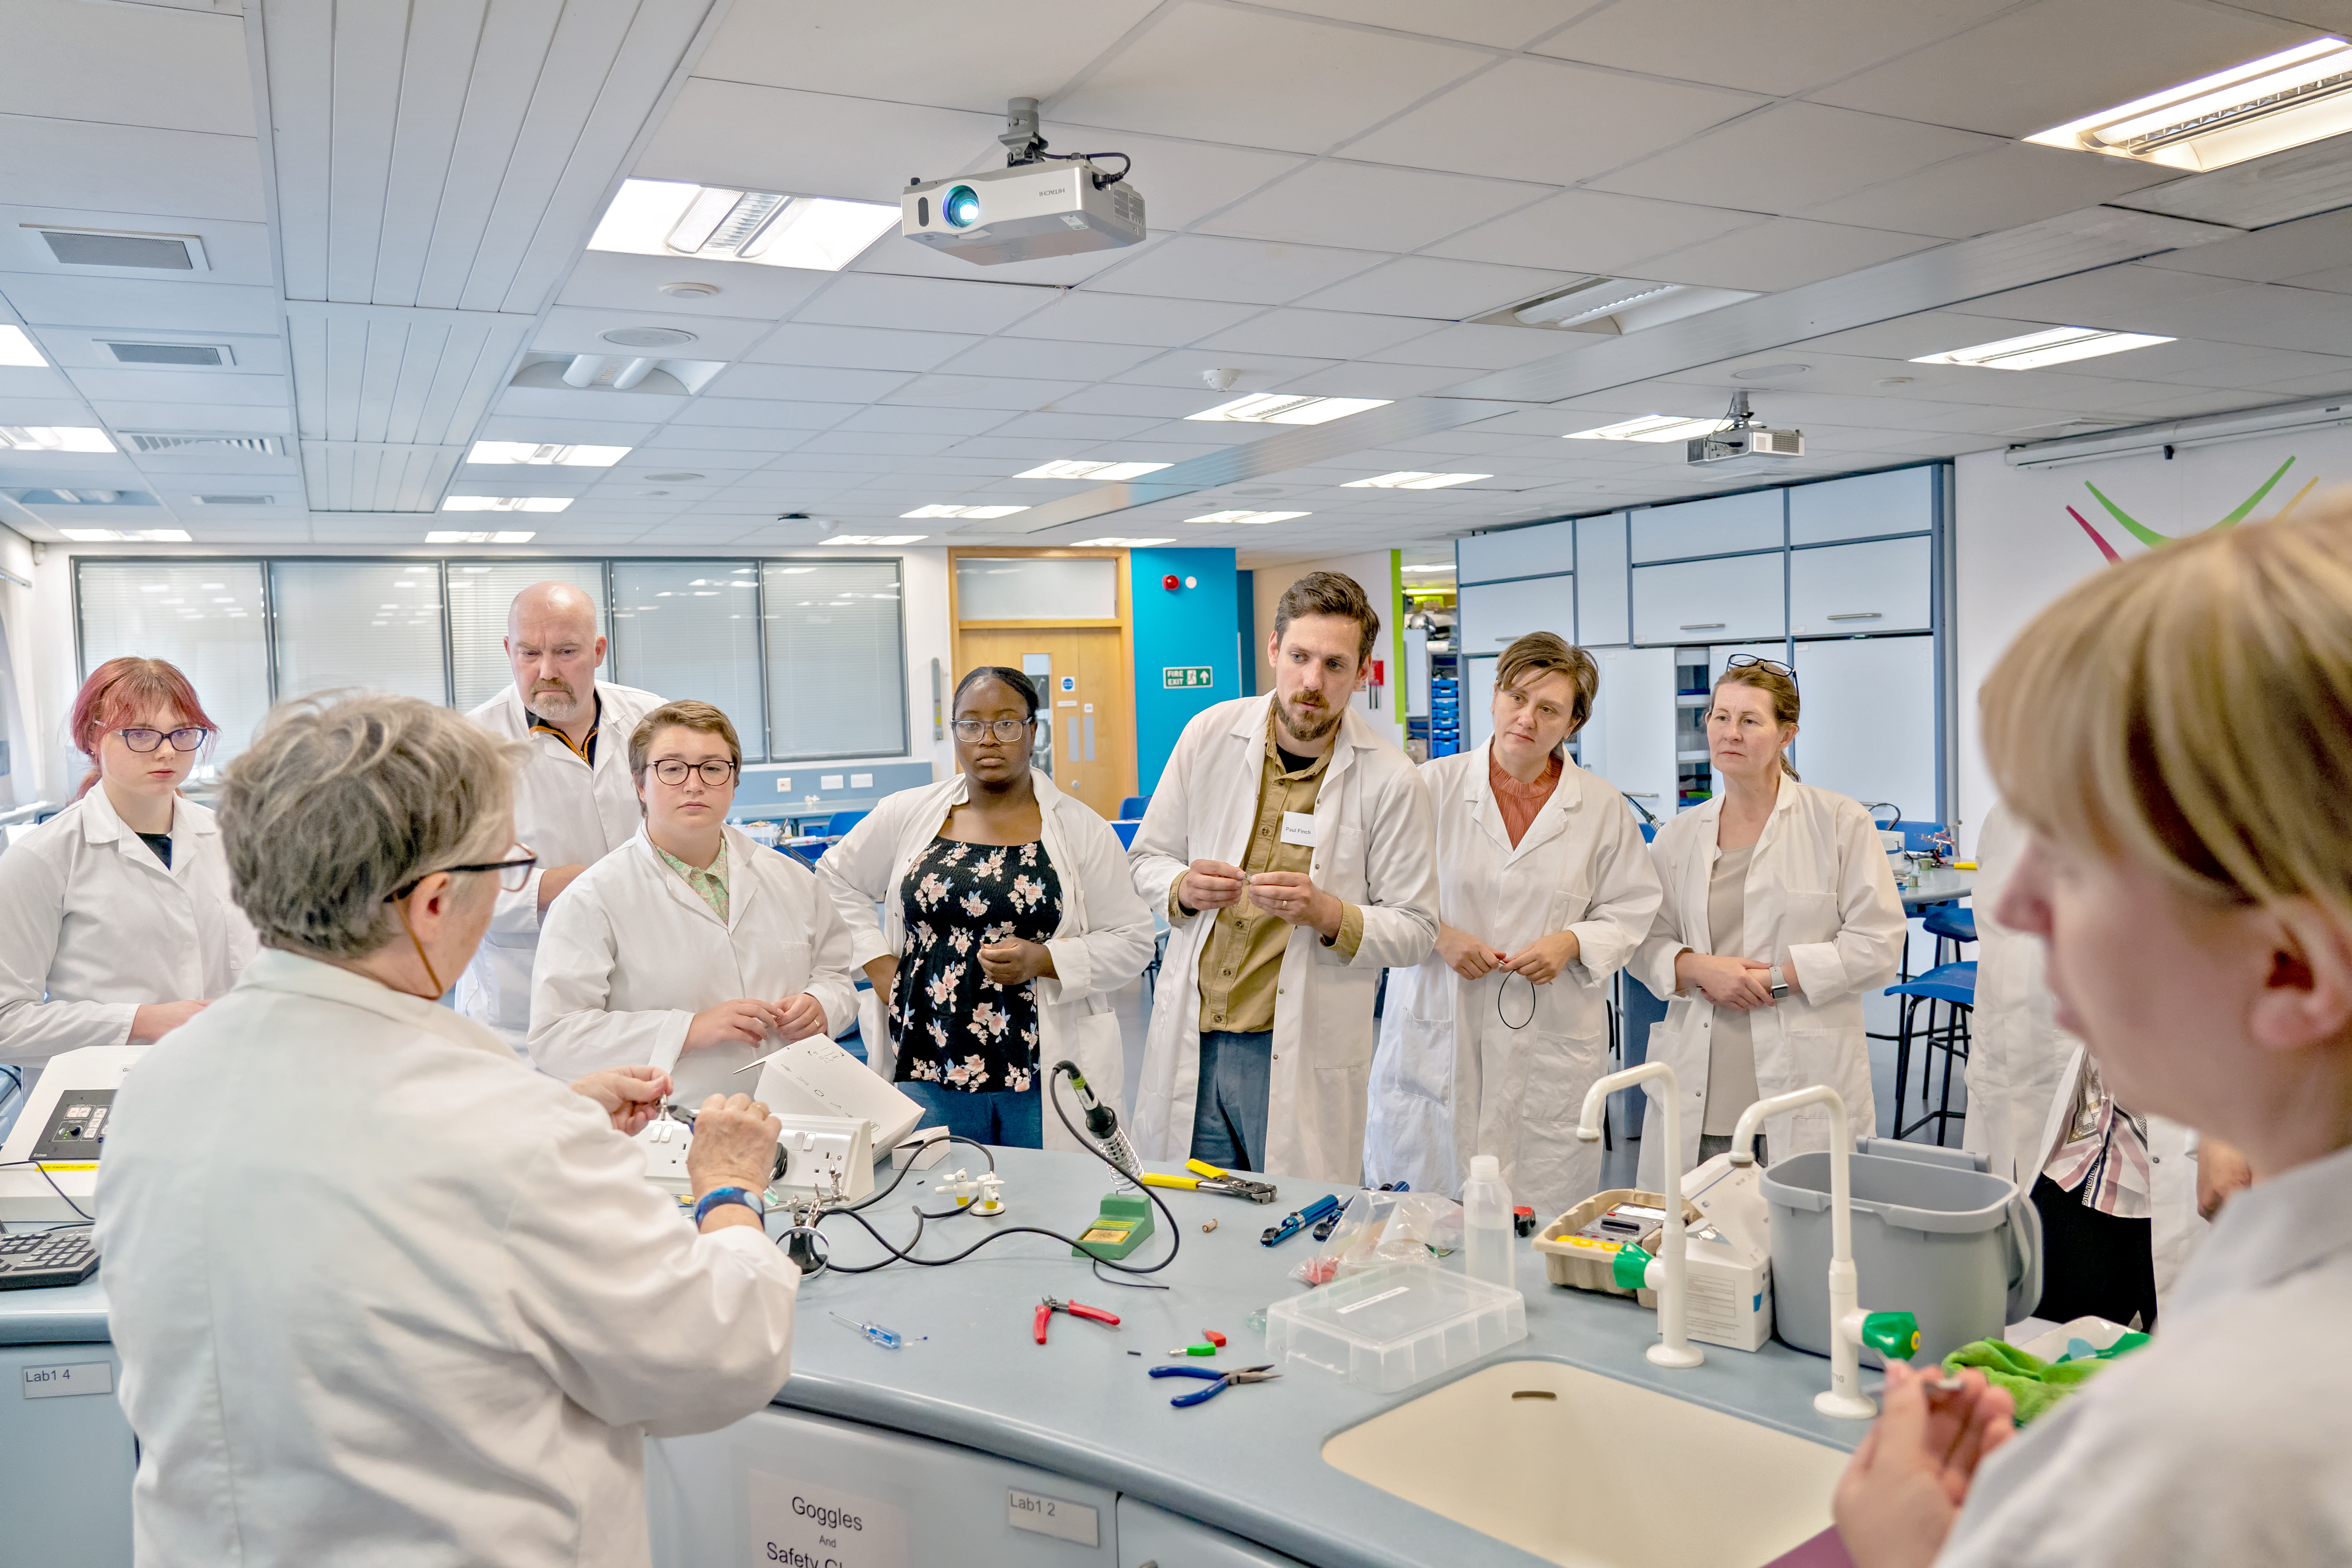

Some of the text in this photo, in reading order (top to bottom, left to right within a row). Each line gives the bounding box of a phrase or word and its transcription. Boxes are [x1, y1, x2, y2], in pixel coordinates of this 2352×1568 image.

[1039, 188, 1065, 197] HITACHI
[26, 1369, 70, 1382] Lab1 4
[1010, 1493, 1055, 1516] Lab1 2
[792, 1496, 862, 1531] Goggles
[819, 1535, 836, 1548] And
